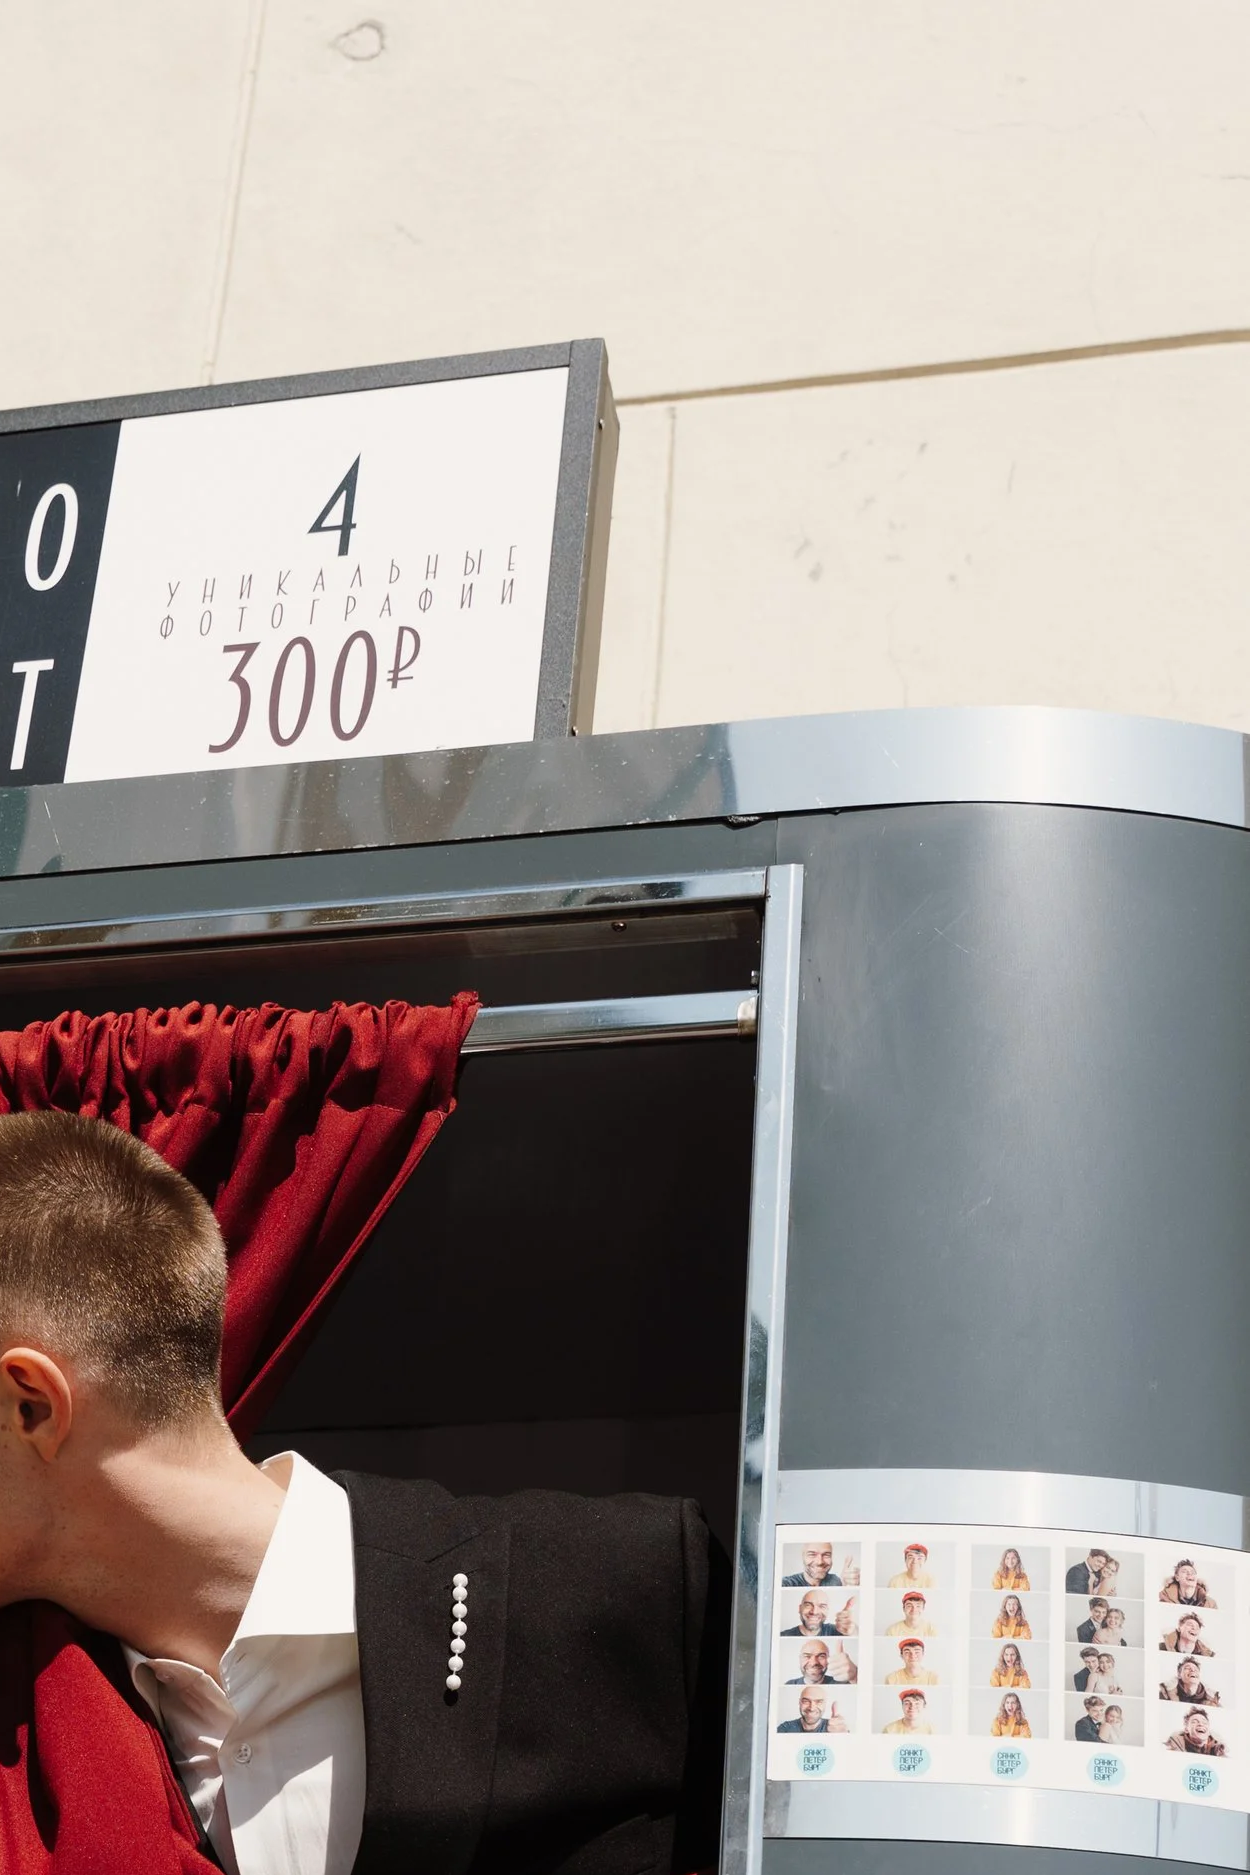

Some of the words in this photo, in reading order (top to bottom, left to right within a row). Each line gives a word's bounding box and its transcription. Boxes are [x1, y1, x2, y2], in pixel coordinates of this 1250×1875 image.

[307, 453, 361, 556] 4
[159, 578, 514, 640] ФОТОГРАФИИ
[167, 545, 517, 607] УНИКАЛЬНЫЕ
[208, 625, 421, 753] 300₽
